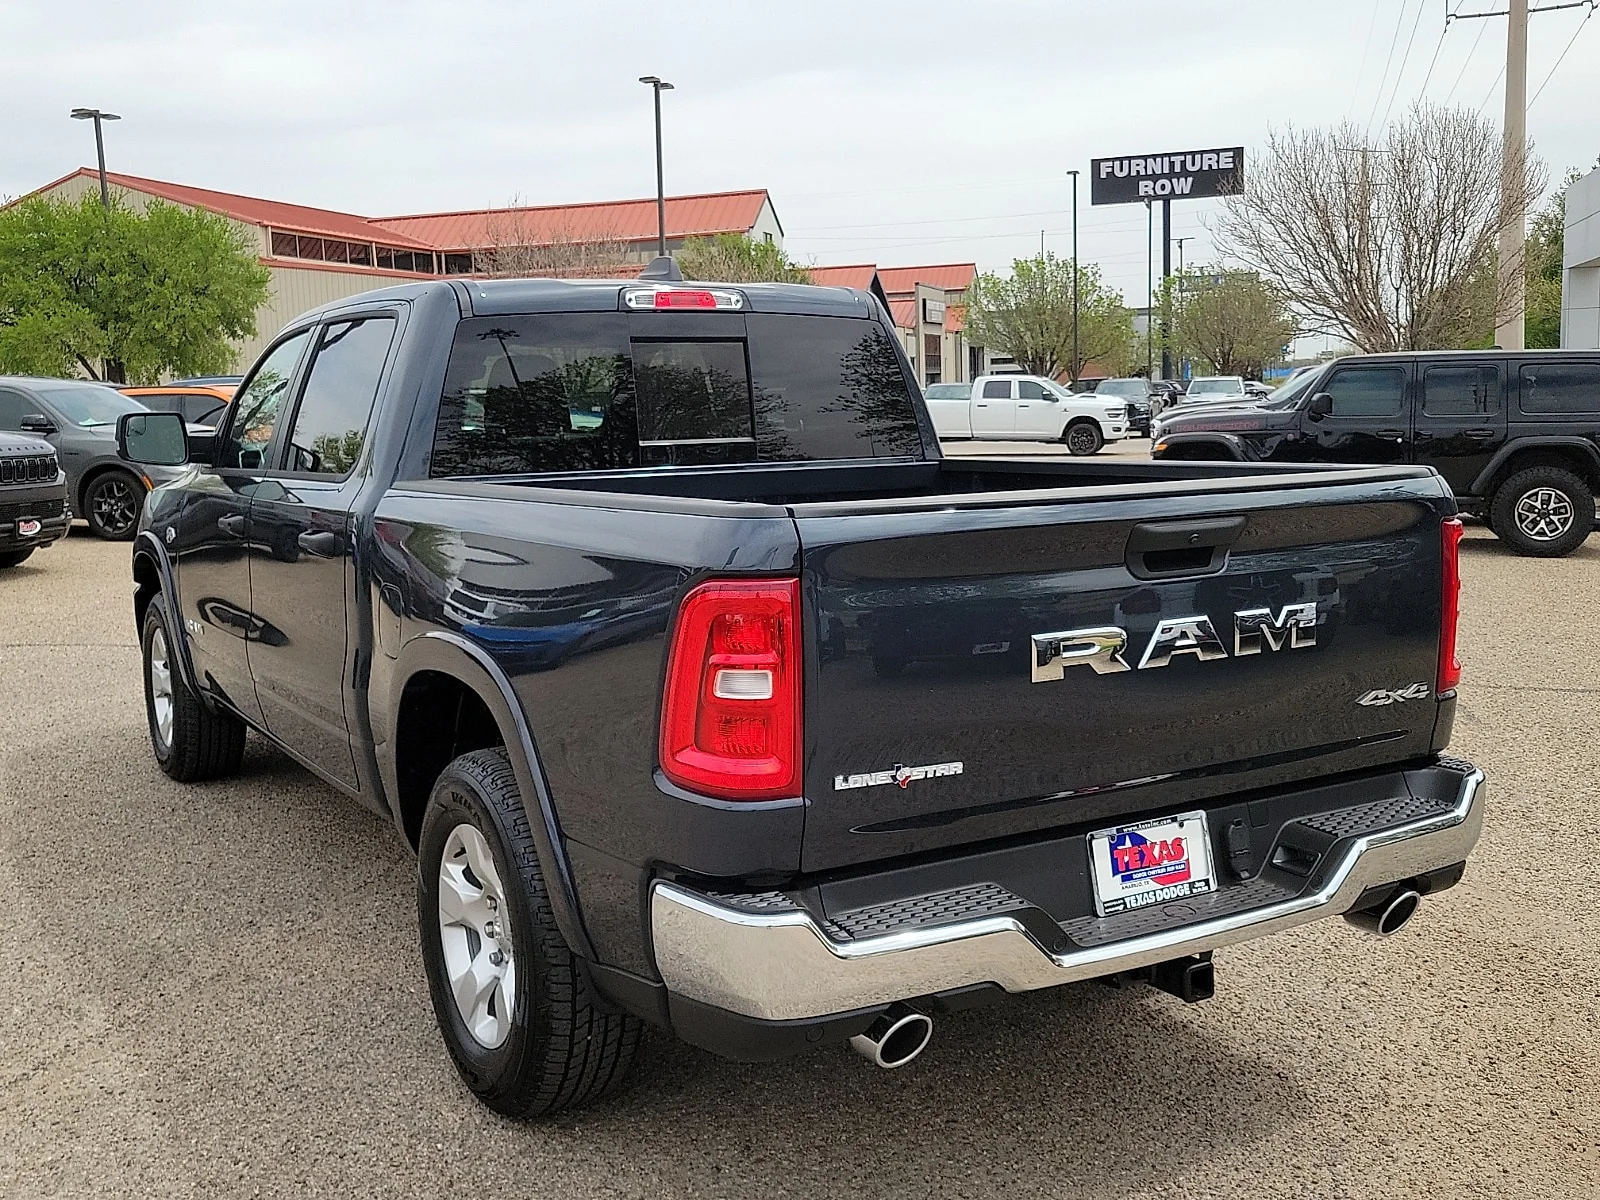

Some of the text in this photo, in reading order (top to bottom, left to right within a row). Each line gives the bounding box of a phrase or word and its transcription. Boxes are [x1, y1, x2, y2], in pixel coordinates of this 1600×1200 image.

[1099, 151, 1234, 179] FURNITURE
[1138, 177, 1194, 197] ROW
[1030, 601, 1318, 683] RAM
[834, 761, 964, 790] LONE STAR
[1113, 836, 1185, 872] TEXAS
[1124, 890, 1156, 909] TEXAS
[1155, 883, 1190, 903] DODGE
